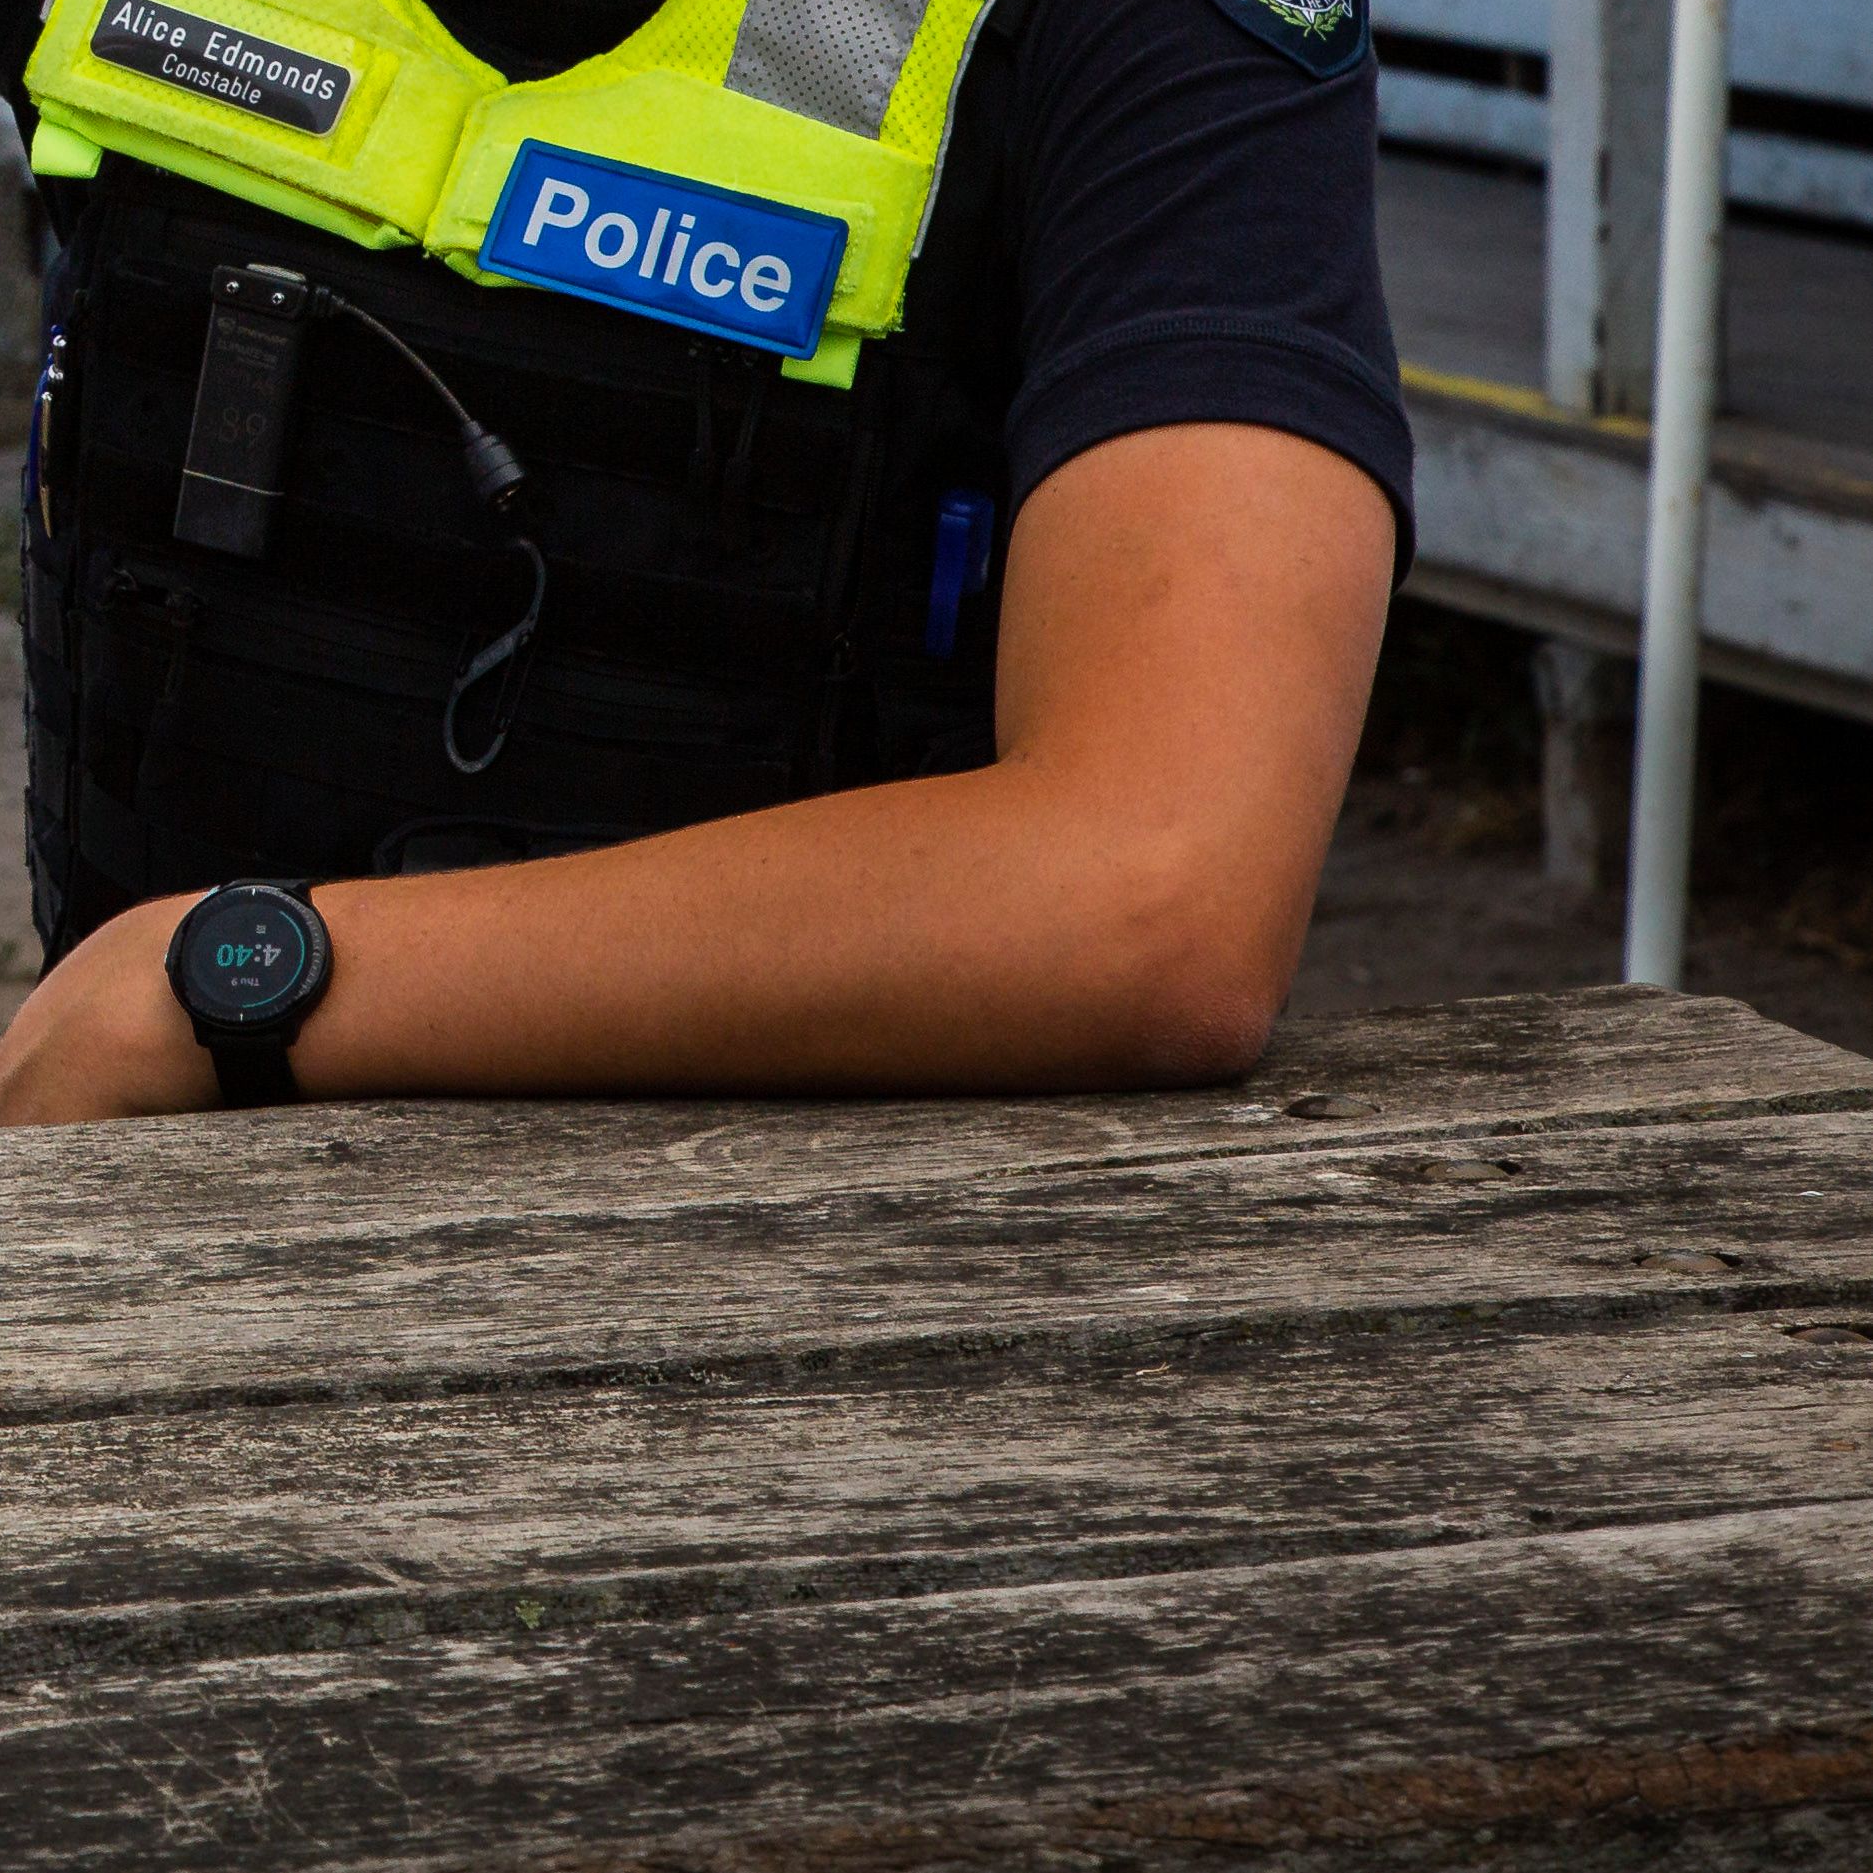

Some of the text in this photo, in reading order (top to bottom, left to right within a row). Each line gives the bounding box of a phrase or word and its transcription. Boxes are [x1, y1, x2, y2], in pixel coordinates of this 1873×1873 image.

[111, 1, 336, 101] Alice Edmonds
[162, 53, 262, 105] Constable
[522, 177, 792, 313] Police
[217, 943, 282, 966] 4:40
[240, 977, 260, 987] Thu
